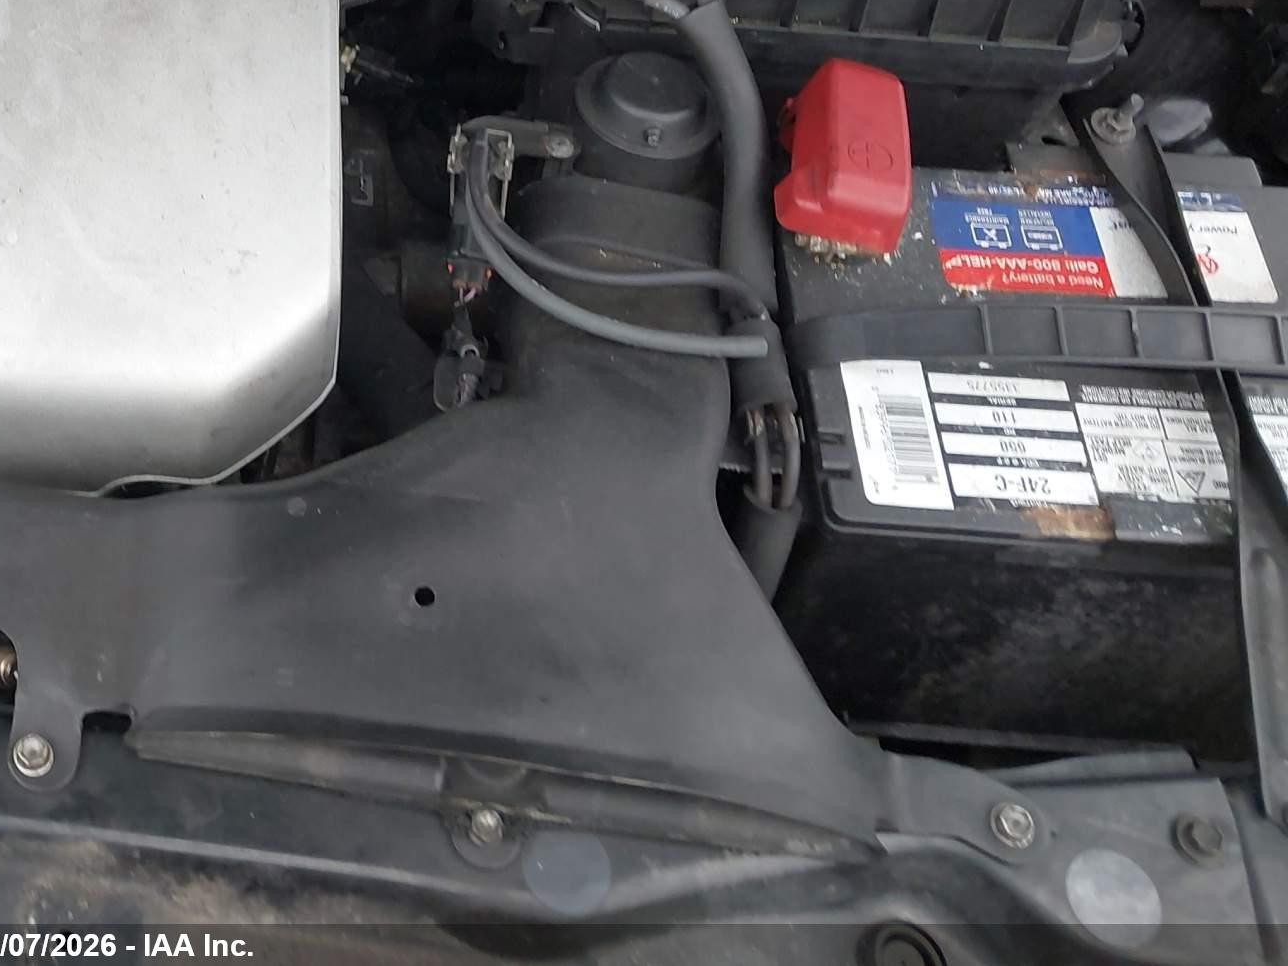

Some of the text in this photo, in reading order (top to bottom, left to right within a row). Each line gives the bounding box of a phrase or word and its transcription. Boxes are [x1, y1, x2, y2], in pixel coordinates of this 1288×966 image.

[1002, 271, 1055, 286] battery?
[1069, 276, 1104, 289] Need
[994, 474, 1052, 495] 24F-C
